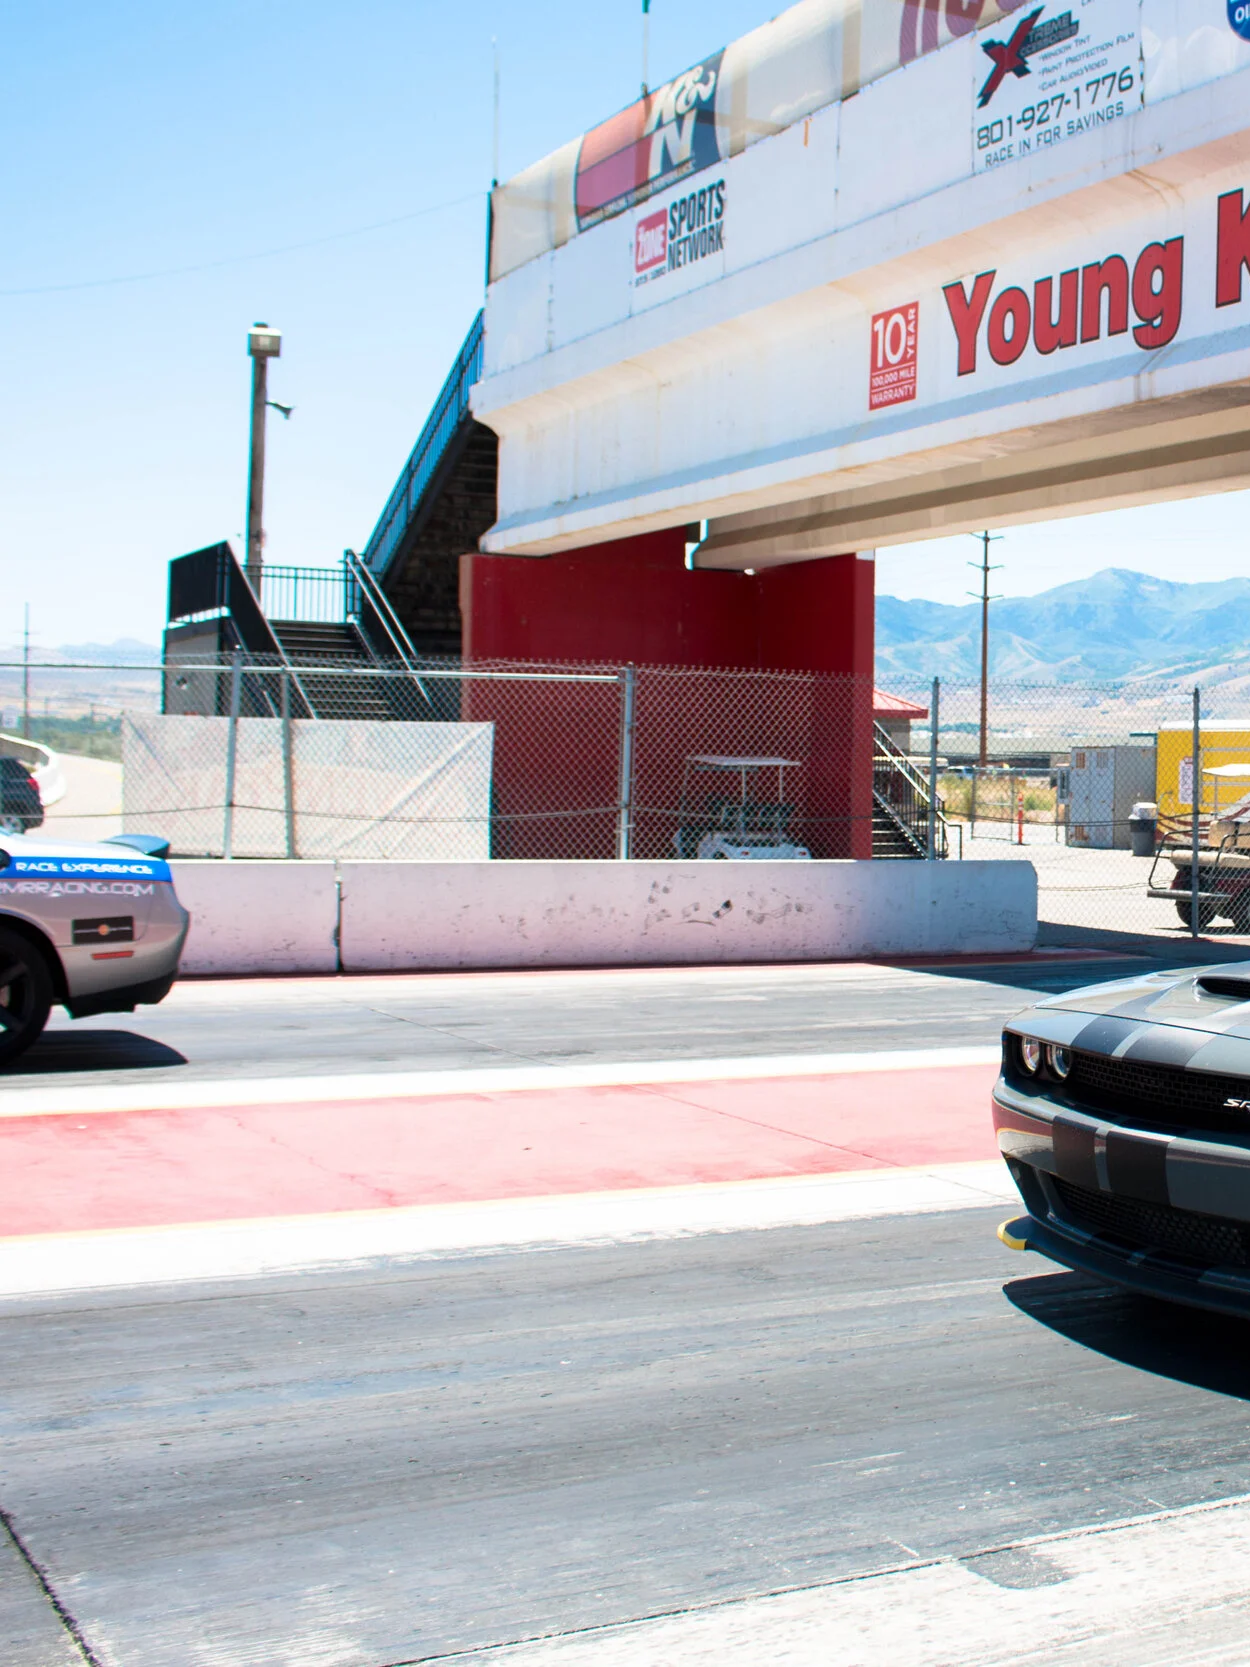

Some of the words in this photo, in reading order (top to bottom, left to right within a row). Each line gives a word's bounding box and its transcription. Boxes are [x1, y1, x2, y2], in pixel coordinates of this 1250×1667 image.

[976, 65, 1134, 151] 801-927-1776
[984, 143, 1014, 169] RACE
[1018, 137, 1031, 155] IN
[1036, 125, 1061, 147] FOR
[1066, 100, 1124, 137] SAVINGS
[668, 177, 726, 241] SPORTS
[667, 219, 725, 273] NETWORK
[942, 235, 1185, 377] Young
[873, 312, 907, 369] 10
[906, 307, 917, 360] YEAR
[871, 382, 916, 405] WARRANTY
[15, 862, 58, 873] RACE
[61, 863, 153, 875] EXPERIENCE
